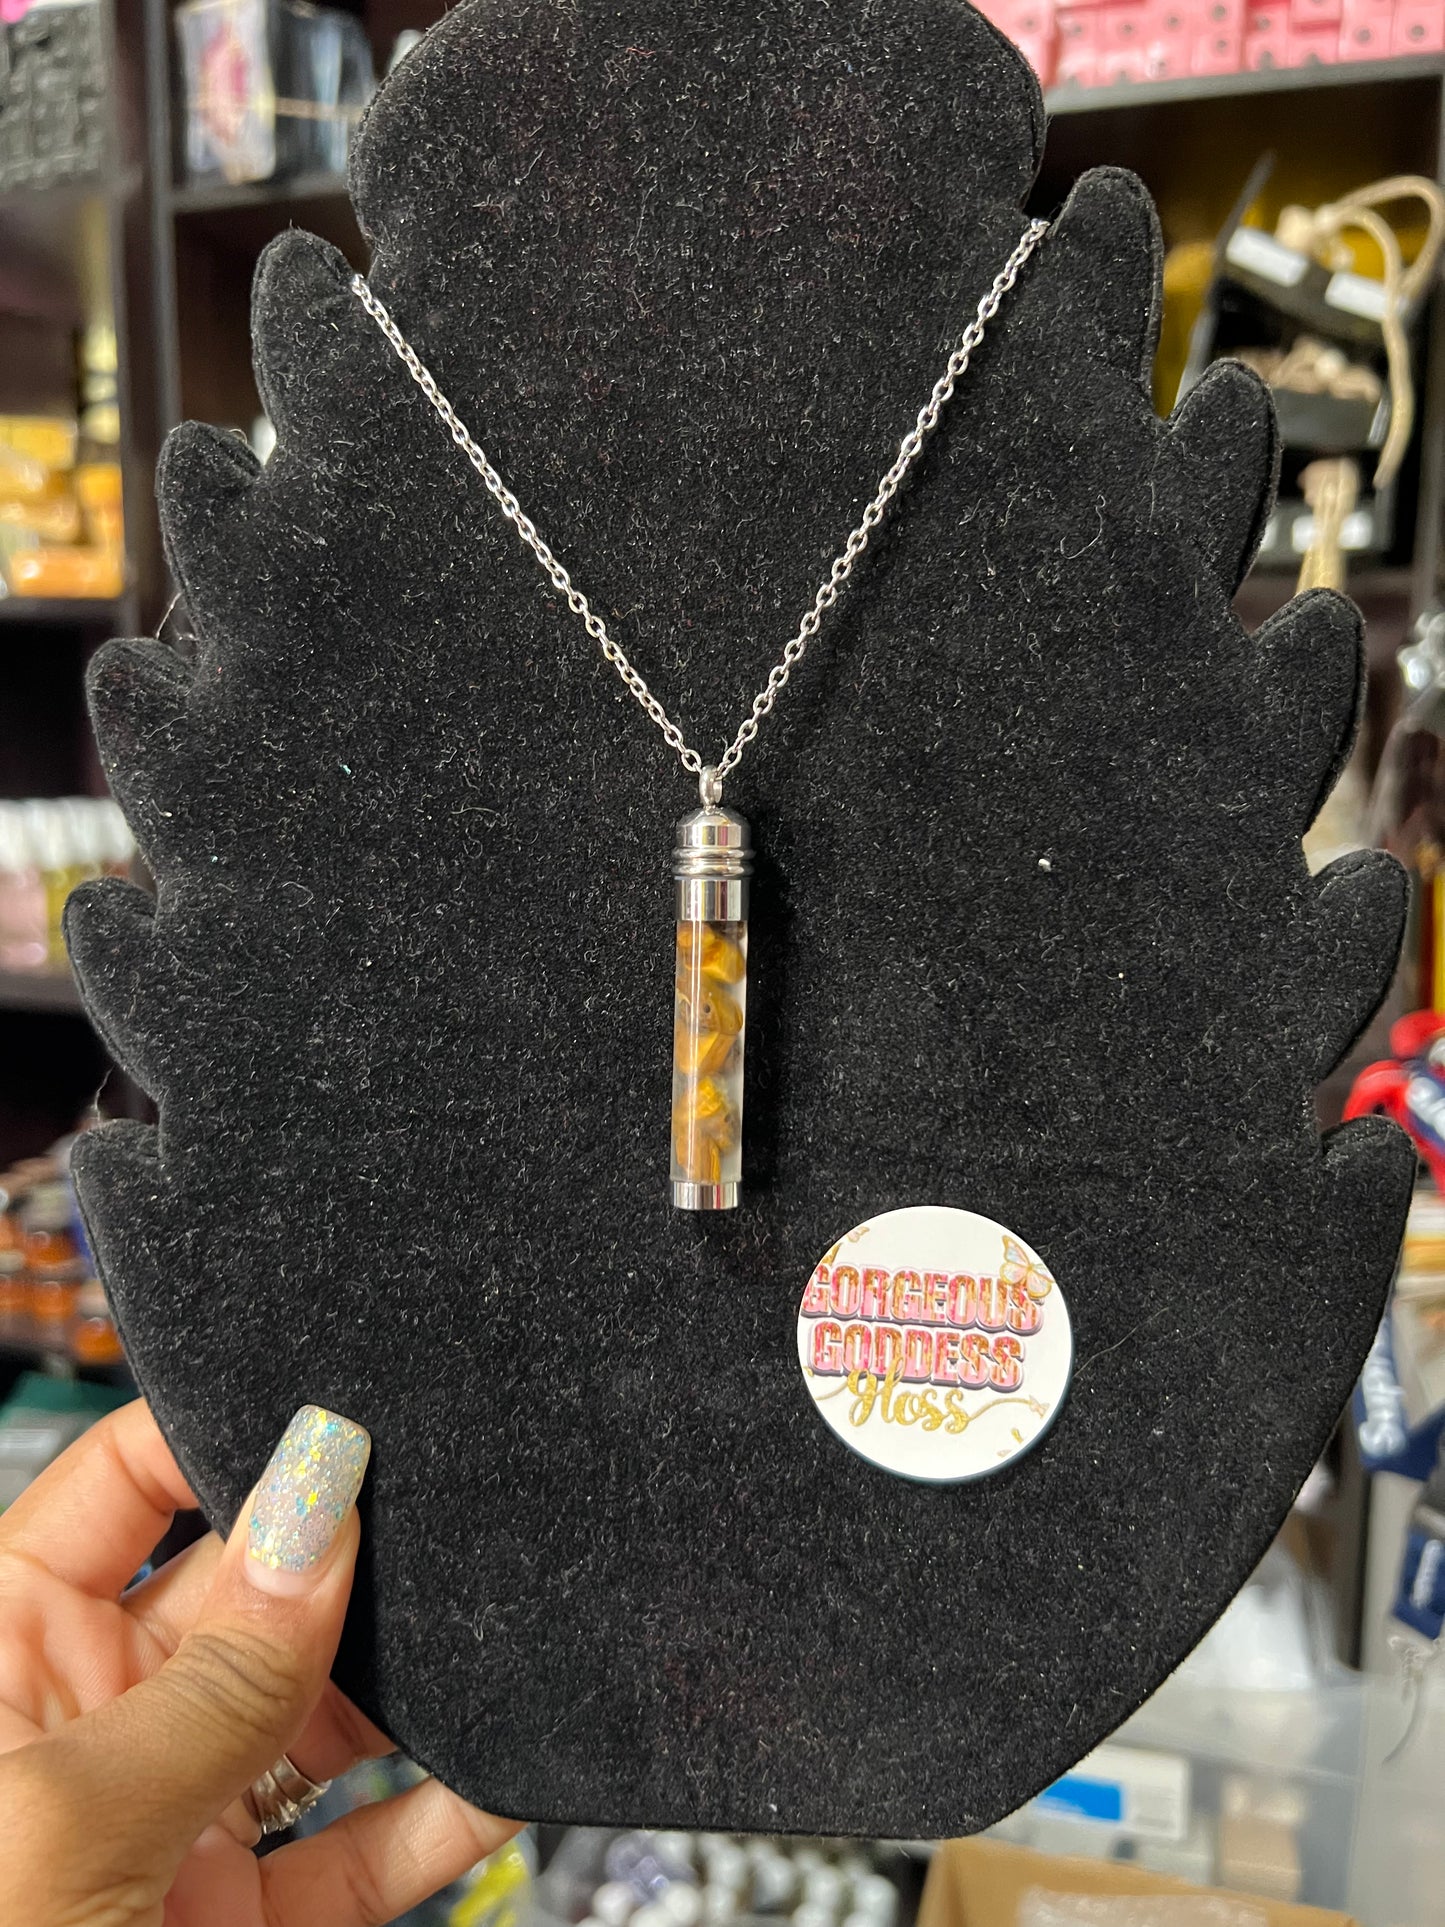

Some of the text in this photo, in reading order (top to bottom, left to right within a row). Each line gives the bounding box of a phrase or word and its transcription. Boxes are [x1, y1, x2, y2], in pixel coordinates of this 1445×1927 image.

[800, 1264, 1044, 1334] GORGEOUS
[810, 1320, 1025, 1392] GODDESS
[847, 1356, 969, 1434] gloss
